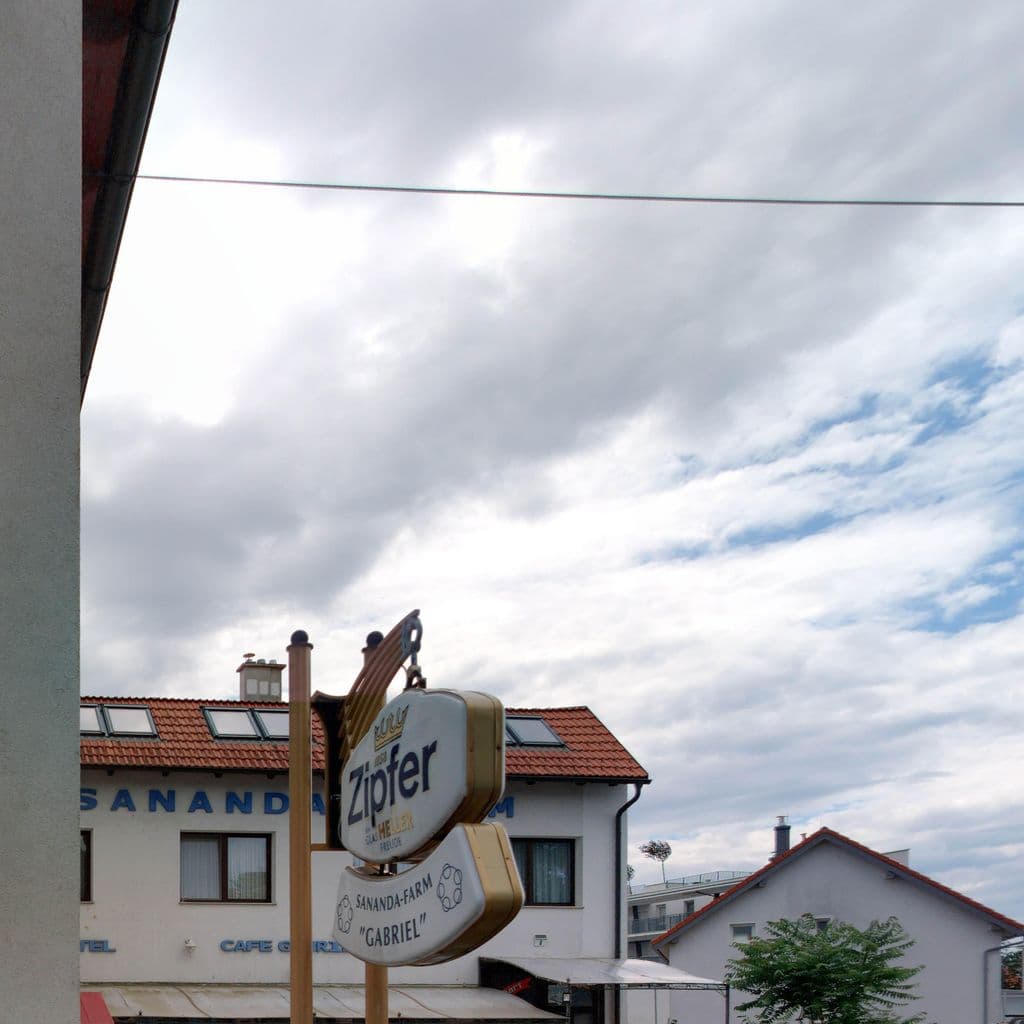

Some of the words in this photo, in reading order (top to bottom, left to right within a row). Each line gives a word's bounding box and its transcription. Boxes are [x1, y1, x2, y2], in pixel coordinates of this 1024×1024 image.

[348, 740, 438, 828] Zipfer
[356, 873, 433, 912] SANANDA-FARM
[220, 940, 274, 953] CAFE
